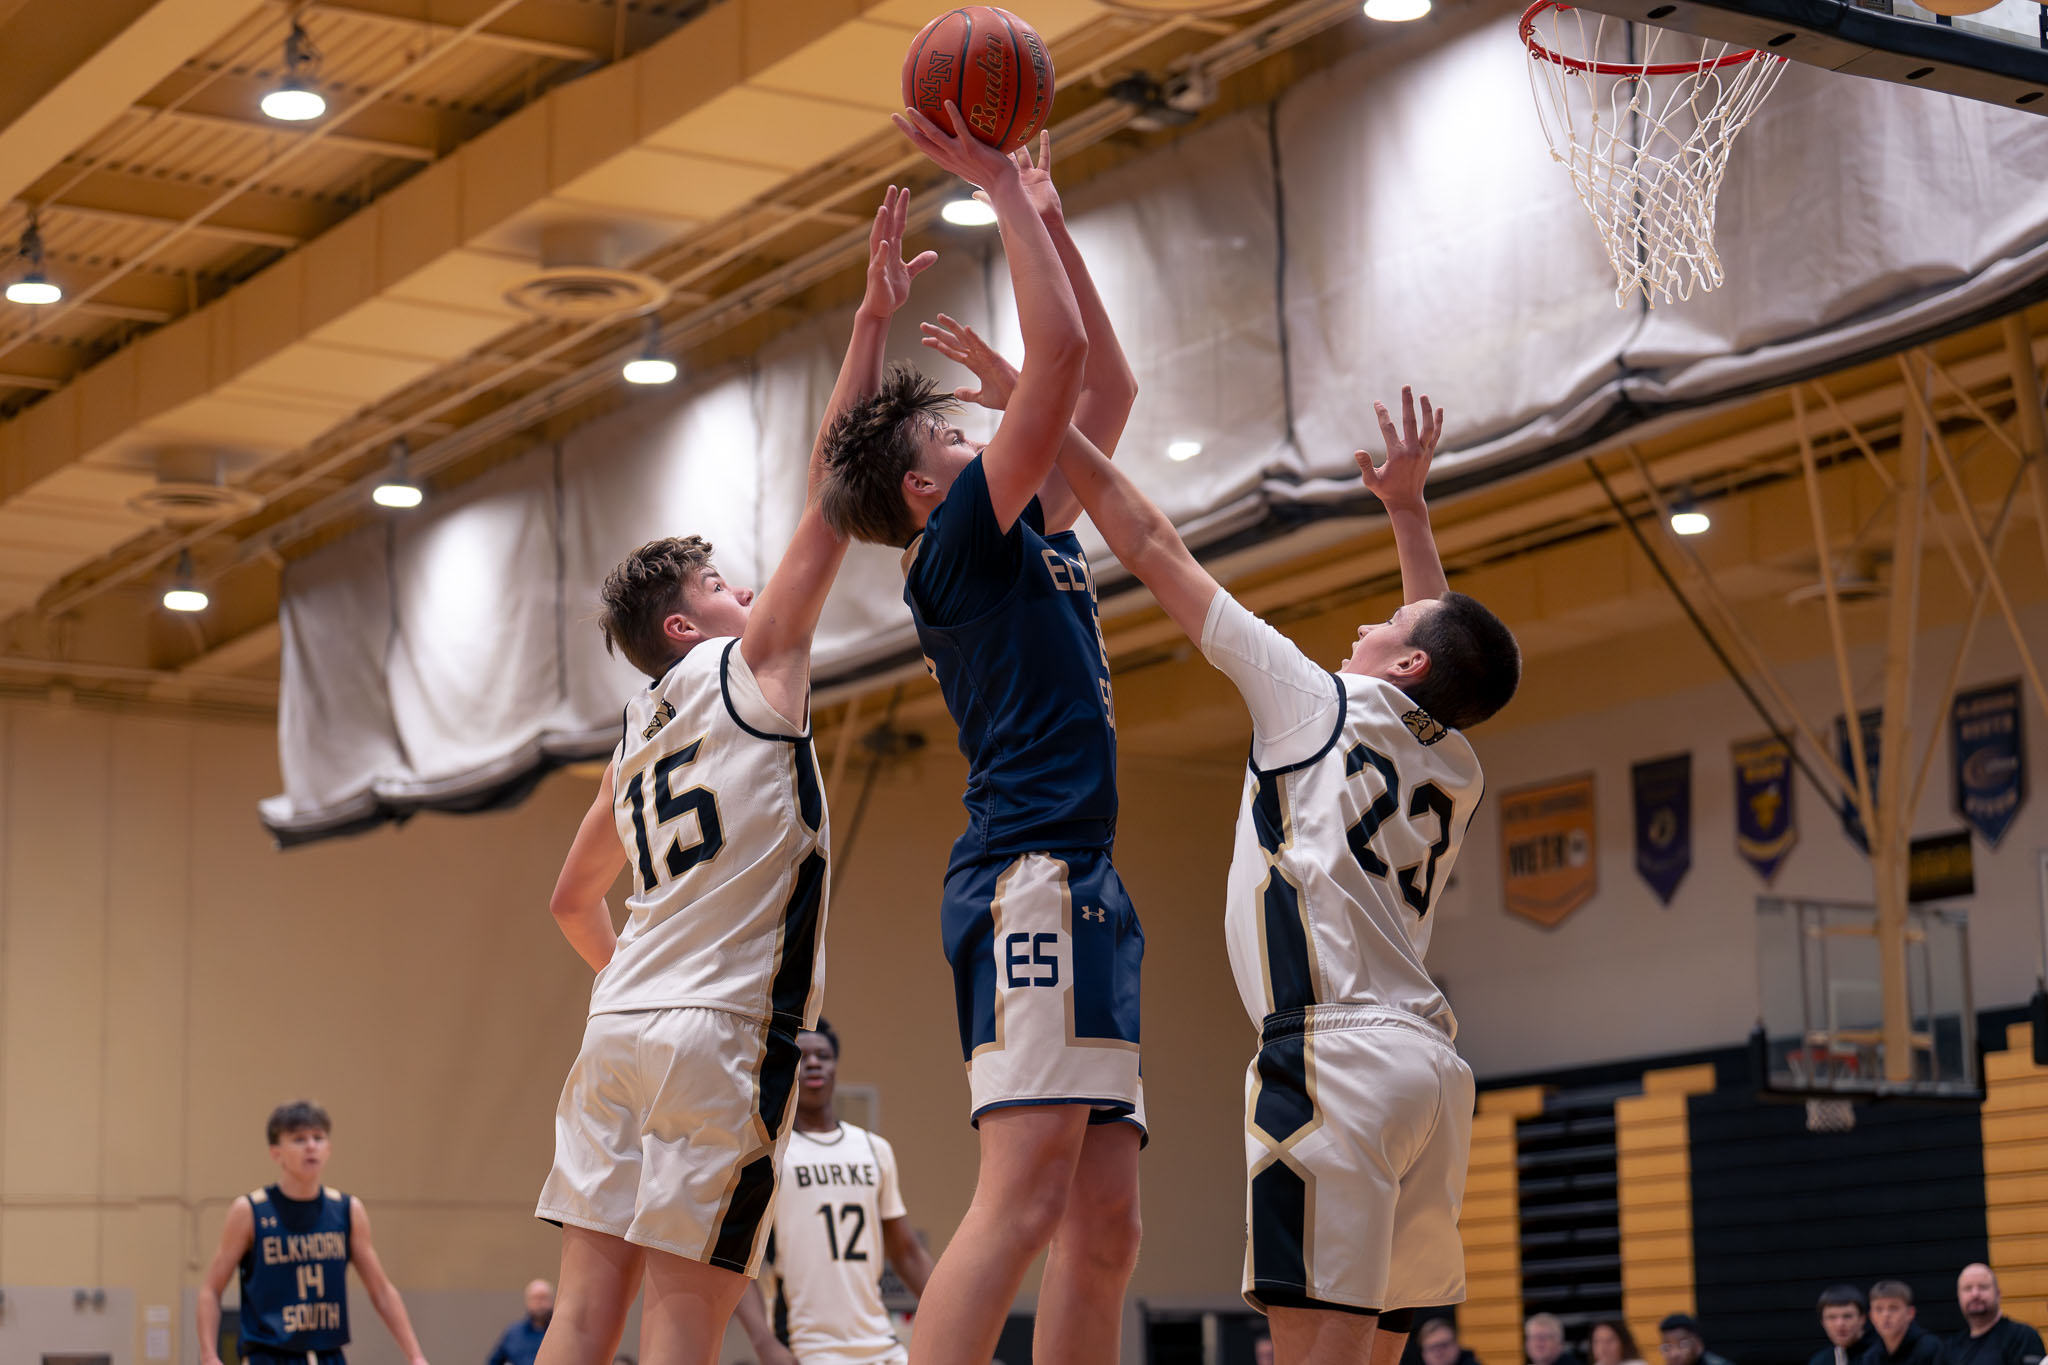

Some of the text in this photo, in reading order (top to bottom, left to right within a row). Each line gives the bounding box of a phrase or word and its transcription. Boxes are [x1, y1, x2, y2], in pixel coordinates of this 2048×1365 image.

[970, 33, 1003, 136] Baden
[623, 731, 727, 895] 15
[1006, 932, 1059, 989] ES
[795, 1164, 875, 1189] BURKE
[263, 1231, 346, 1265] ELKHORN
[817, 1203, 868, 1262] 12
[295, 1263, 326, 1300] 14
[282, 1301, 341, 1333] SOUTH
